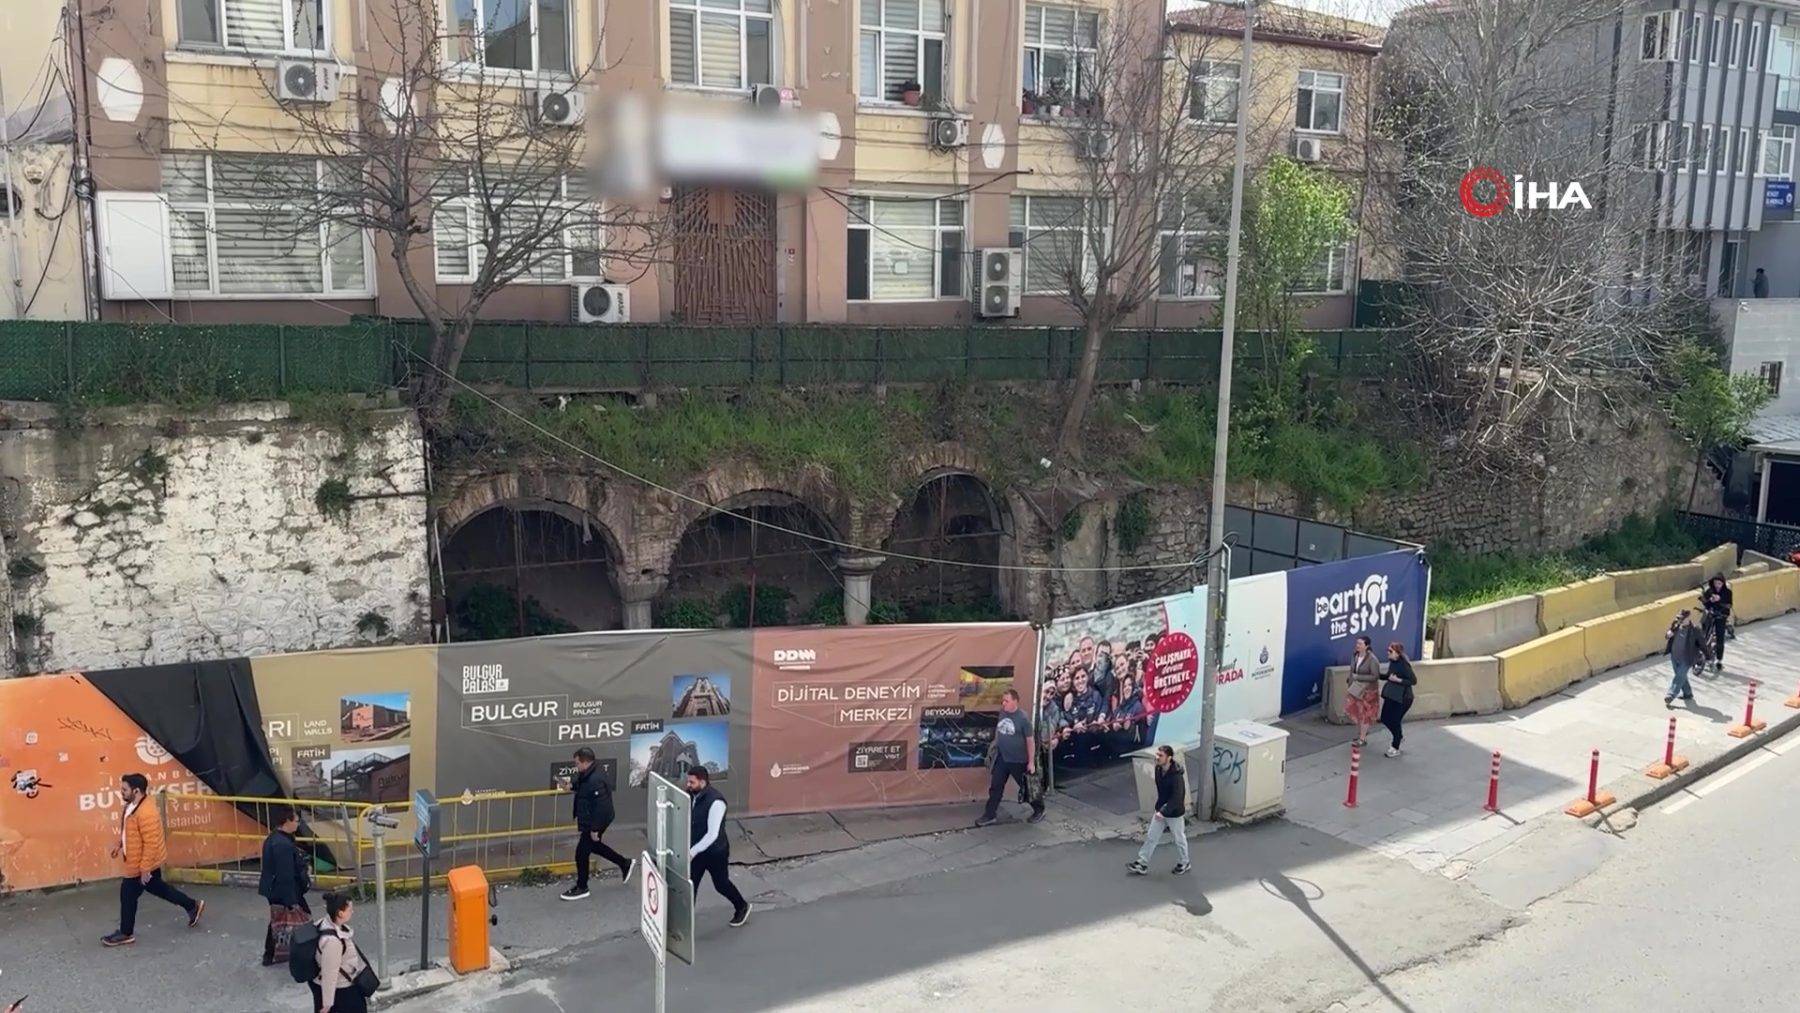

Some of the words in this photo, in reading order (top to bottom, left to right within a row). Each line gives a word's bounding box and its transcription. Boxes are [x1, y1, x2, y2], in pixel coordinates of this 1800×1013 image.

[1315, 582, 1361, 625] part
[1331, 621, 1347, 635] the
[1349, 601, 1404, 634] story
[463, 664, 502, 681] BULGUR
[1216, 668, 1243, 685] RADA
[778, 685, 838, 702] DİJİTAL
[844, 683, 920, 700] DENEYİM
[471, 701, 558, 722] BULGUR
[573, 701, 603, 709] BULGUR
[573, 708, 601, 716] PALACE
[840, 705, 912, 722] MERKEZİ
[925, 708, 961, 716] BEYOĞLU
[266, 719, 292, 738] RI
[304, 720, 327, 728] LAND
[304, 727, 332, 736] WALLS
[558, 721, 624, 740] PALAS
[297, 748, 325, 758] FATİH
[856, 746, 888, 754] ZİYARET
